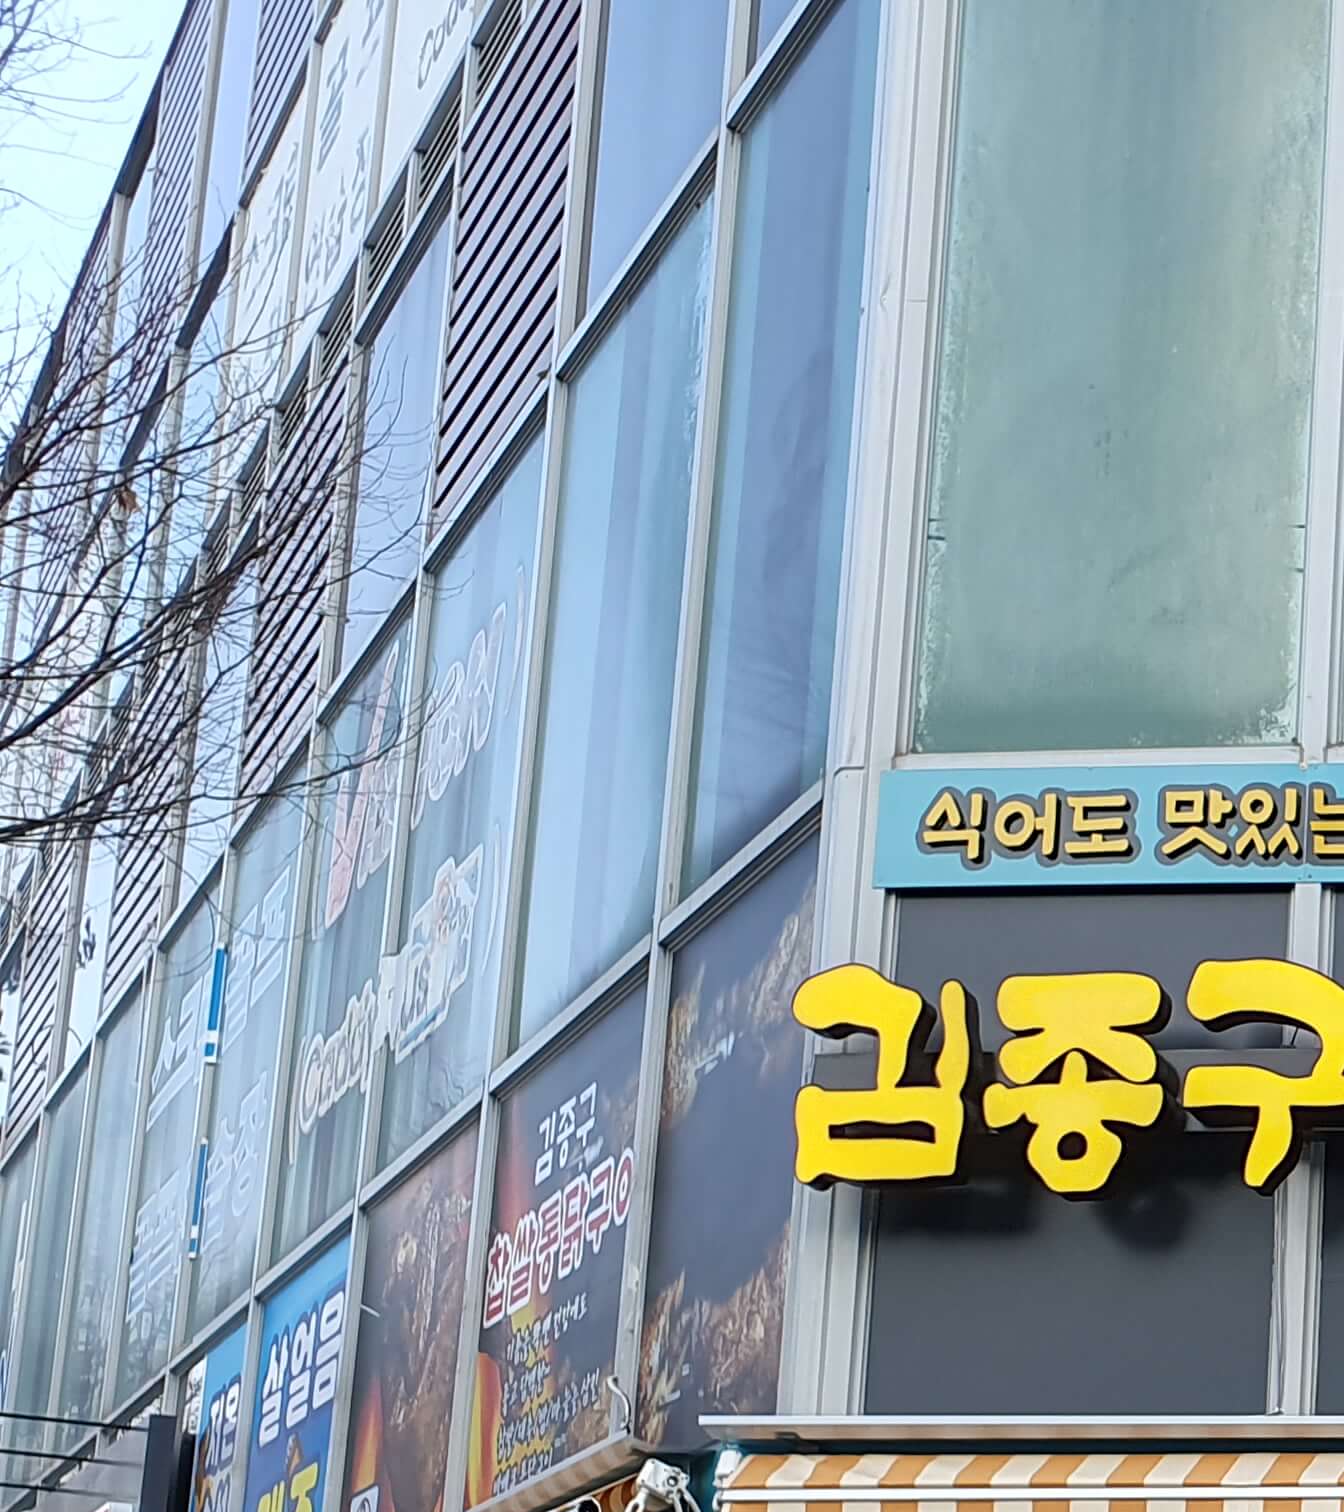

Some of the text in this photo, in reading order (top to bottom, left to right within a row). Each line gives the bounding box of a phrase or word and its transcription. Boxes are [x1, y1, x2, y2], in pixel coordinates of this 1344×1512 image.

[922, 789, 1129, 861] 식어도
[534, 1081, 602, 1187] 김종구
[259, 1289, 345, 1448] 살얼음
[209, 1378, 241, 1473] 저온
